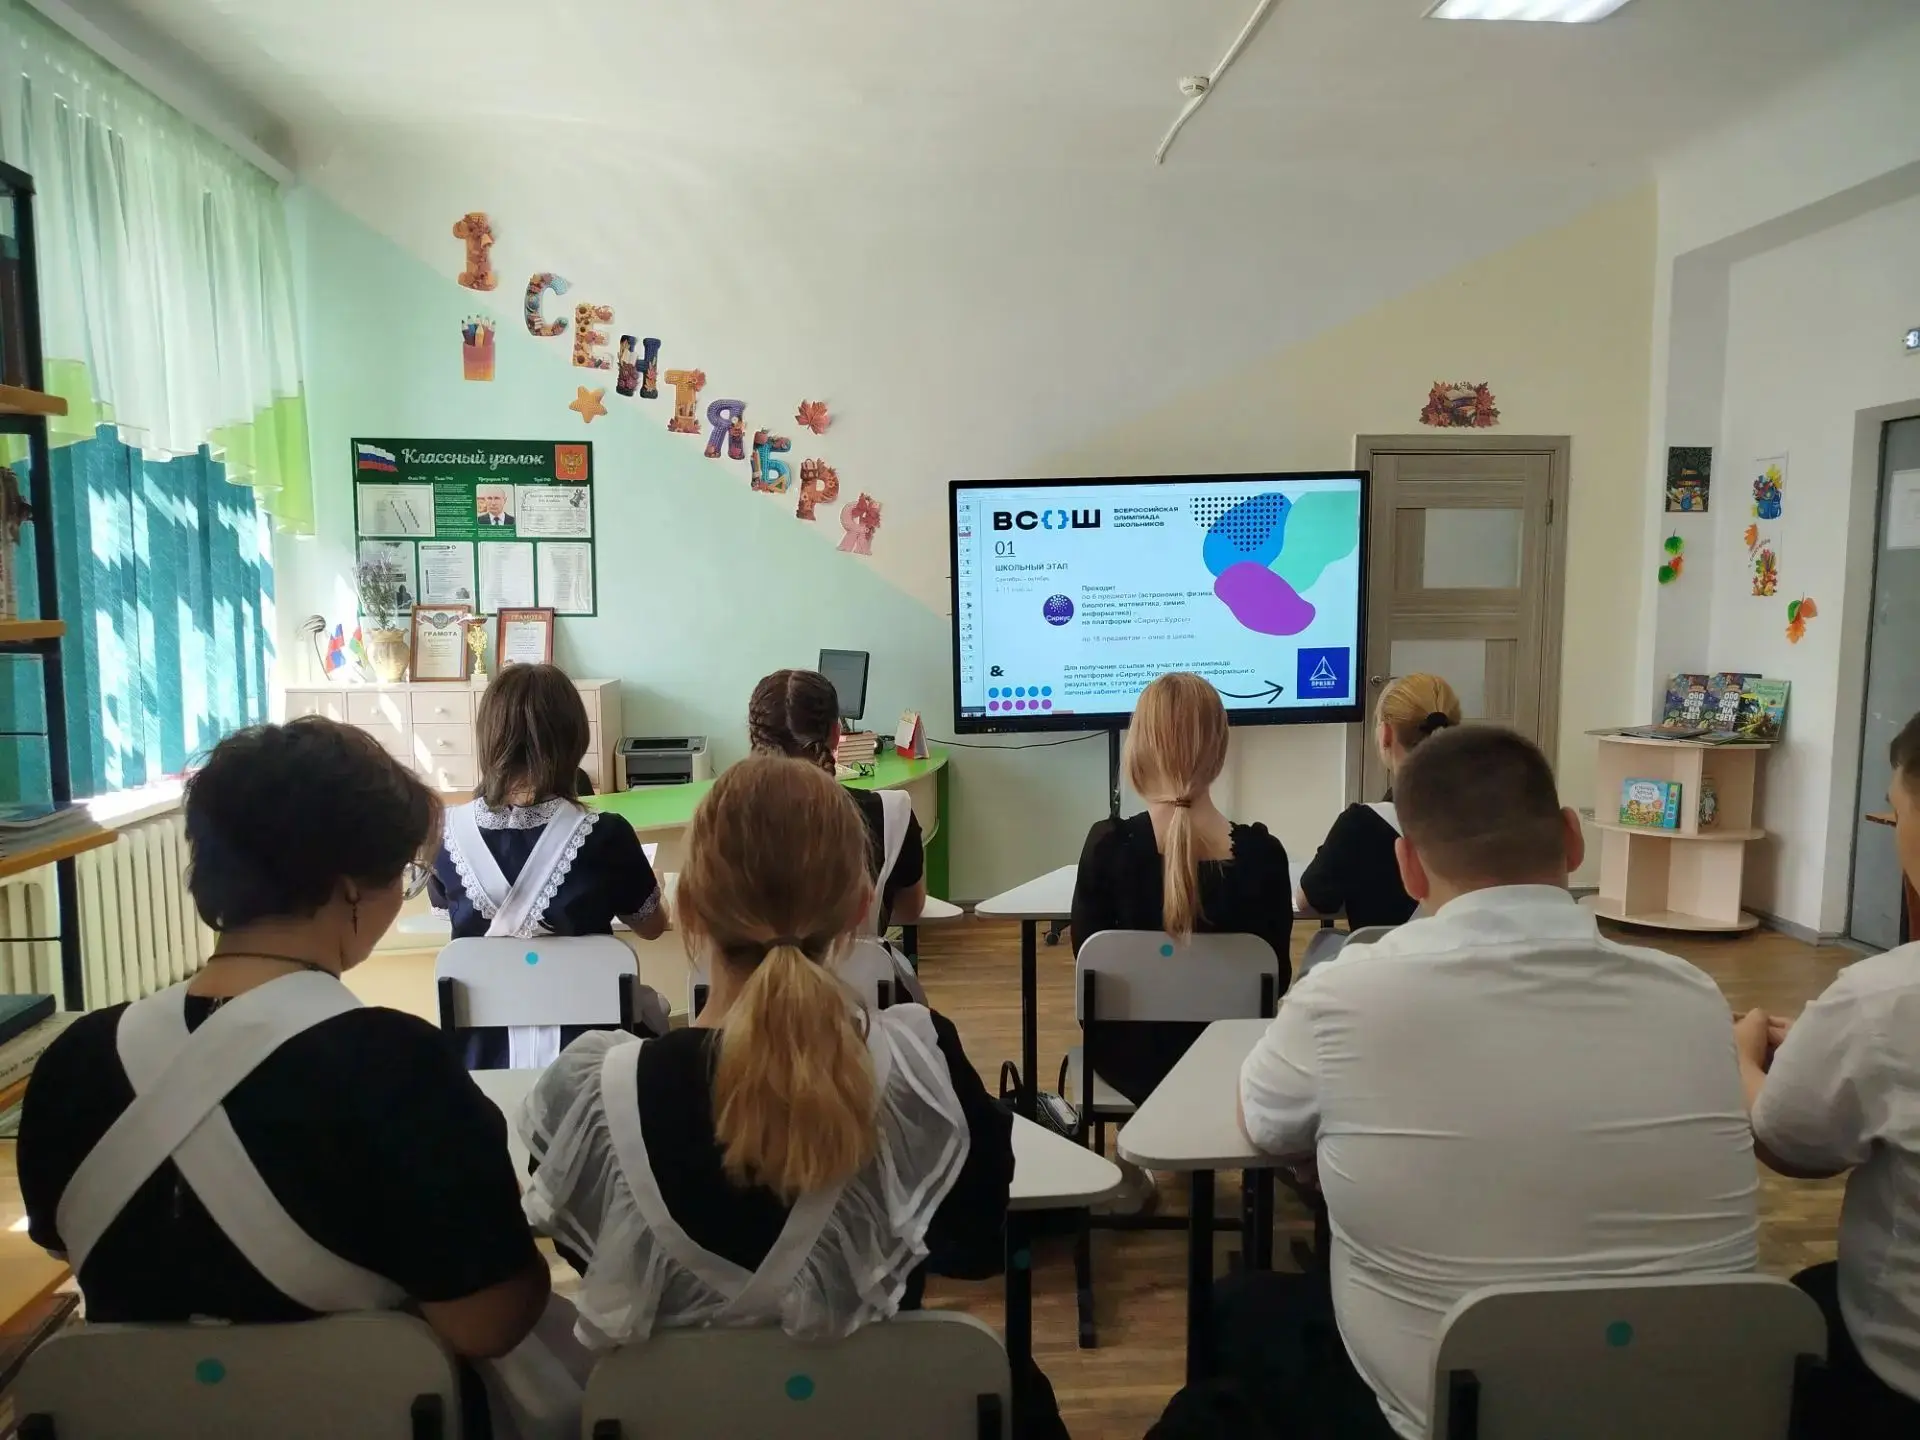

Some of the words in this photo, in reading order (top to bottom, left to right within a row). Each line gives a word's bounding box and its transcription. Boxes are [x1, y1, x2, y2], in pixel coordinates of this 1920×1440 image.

[453, 212, 498, 291] 1
[524, 272, 882, 556] СЕНТЯБРЯ
[401, 449, 487, 465] Классный
[490, 453, 546, 470] уголок
[1113, 506, 1179, 514] ВСЕРОССИЙСКАЯ
[994, 540, 1016, 556] 01
[995, 563, 1045, 572] ШКОЛЬНЫЙ
[1046, 562, 1069, 571] ЭТАП
[1045, 614, 1072, 623] Сириус
